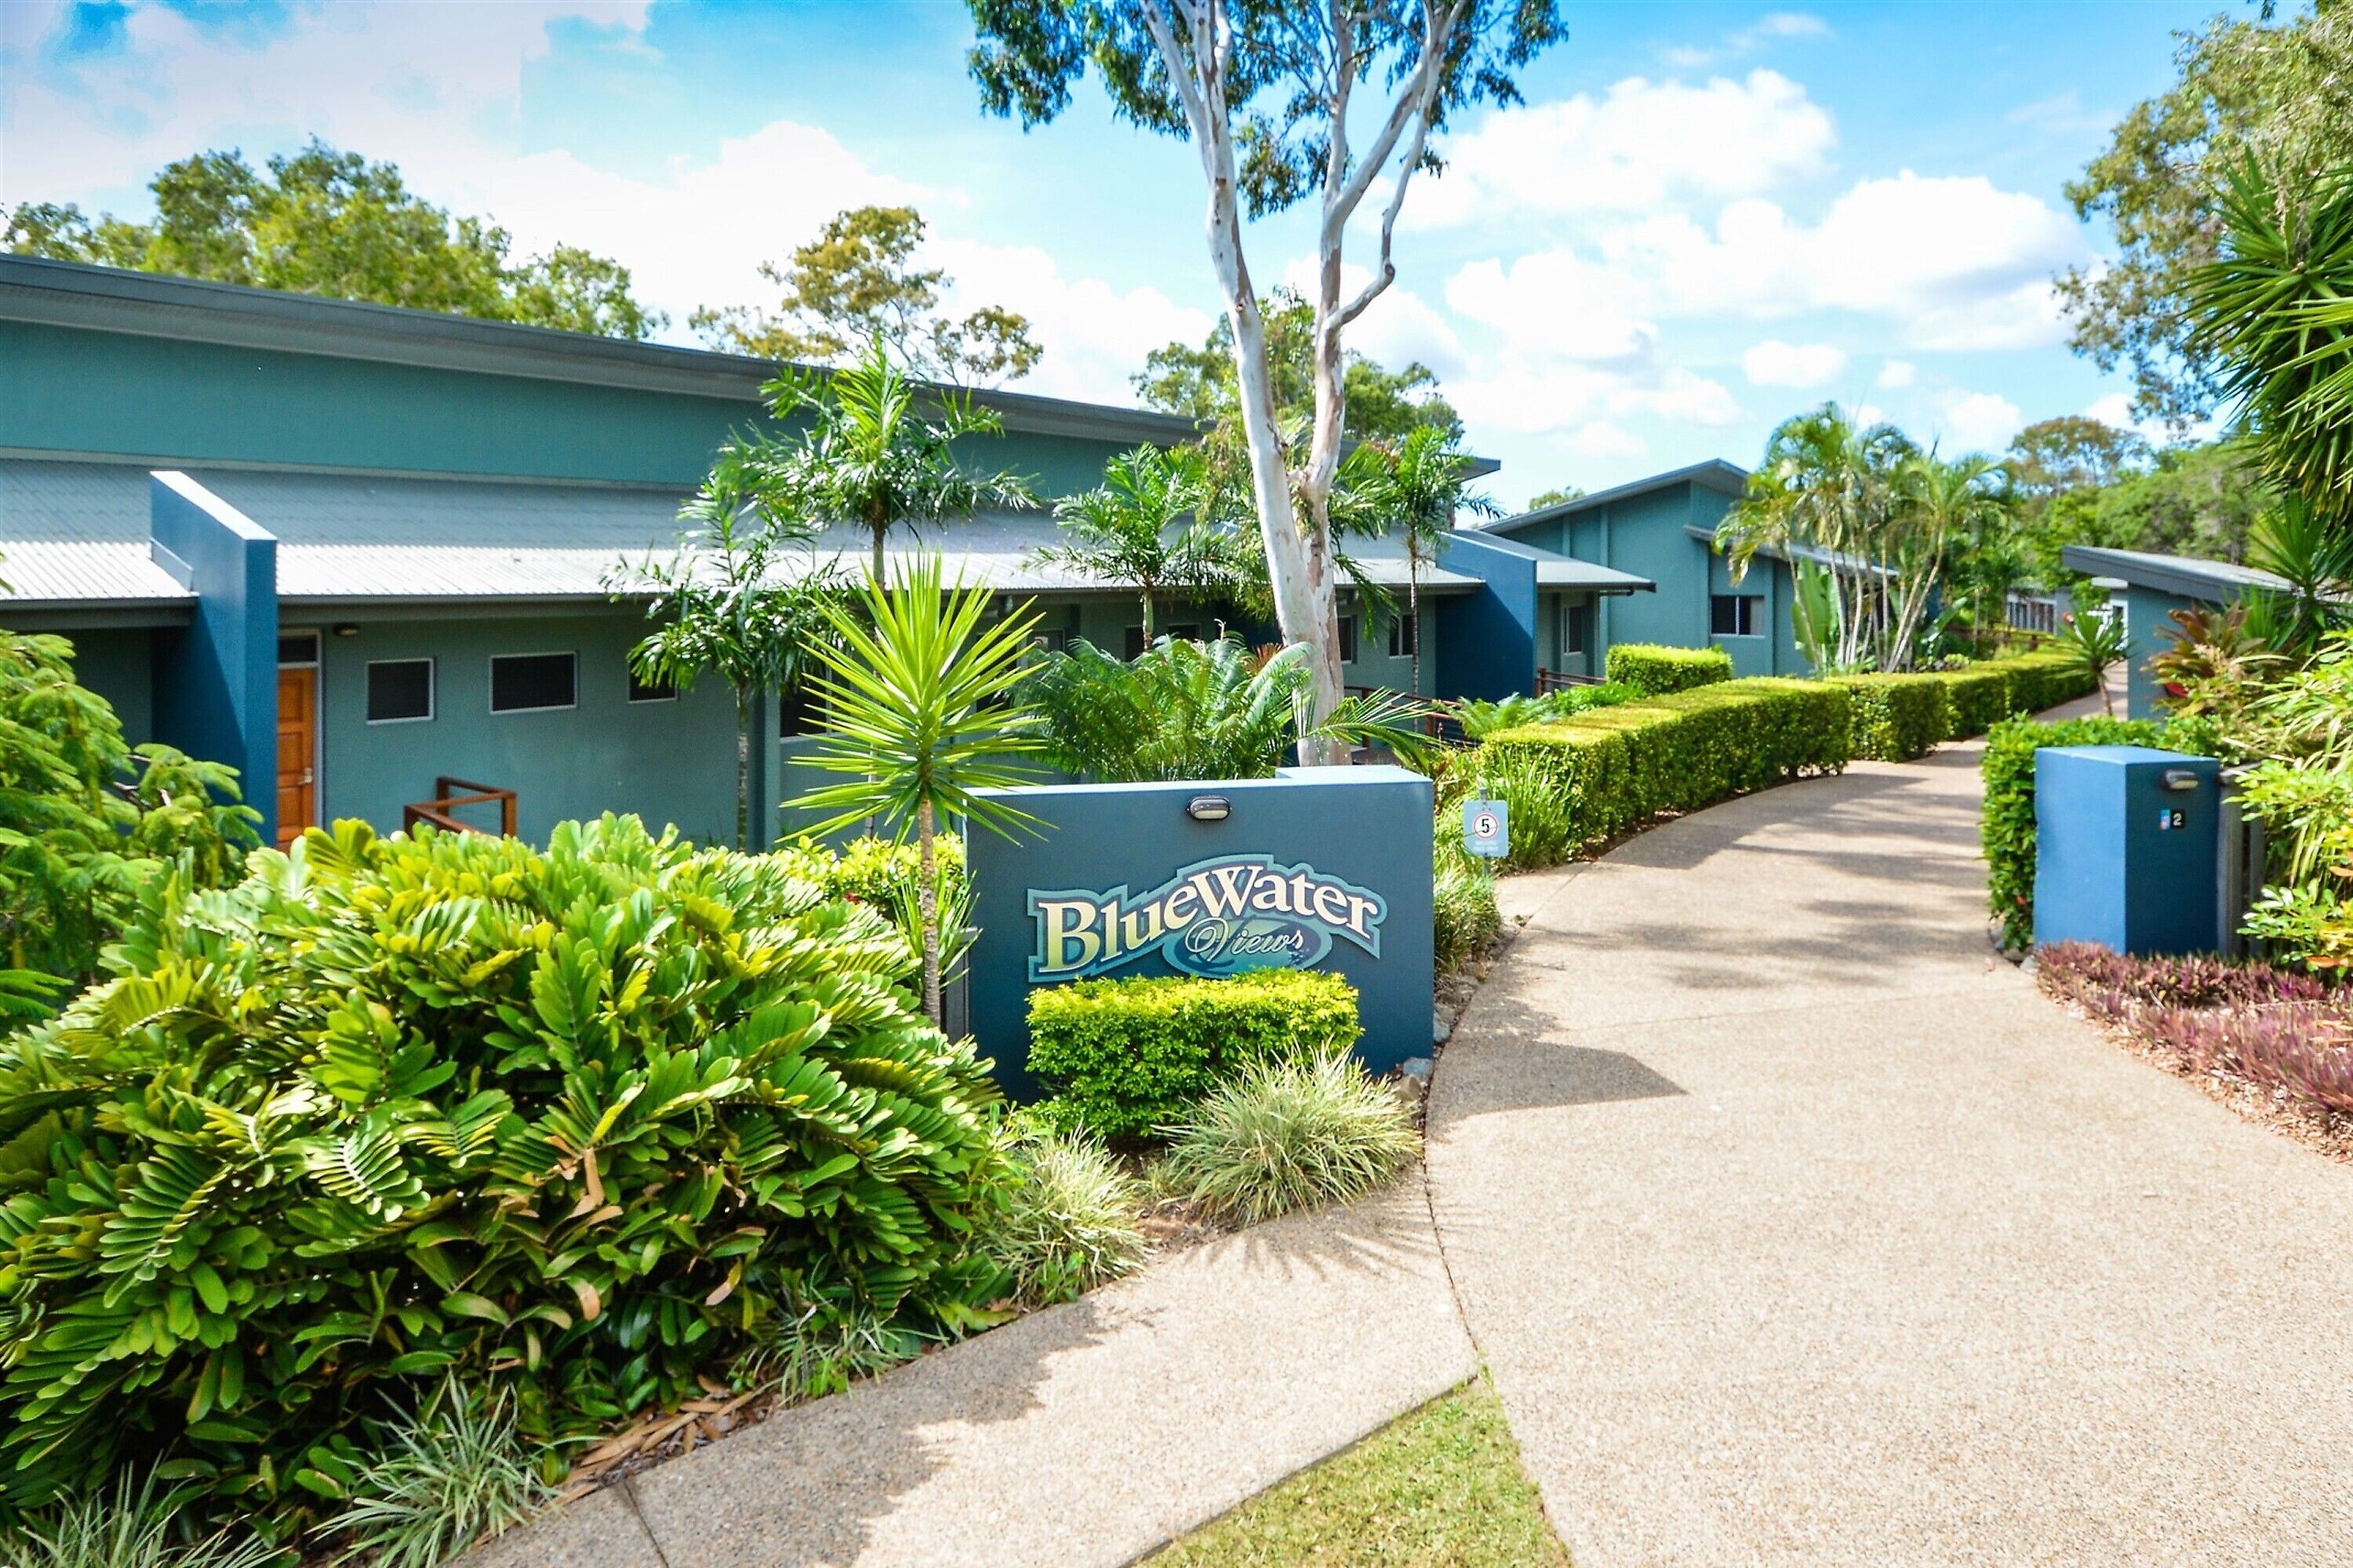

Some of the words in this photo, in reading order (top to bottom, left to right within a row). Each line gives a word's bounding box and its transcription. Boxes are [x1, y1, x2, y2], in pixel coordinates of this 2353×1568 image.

[1481, 818, 1489, 833] 5
[2173, 813, 2182, 826] 2
[1038, 865, 1378, 973] BlueWater
[1184, 917, 1304, 962] Views
